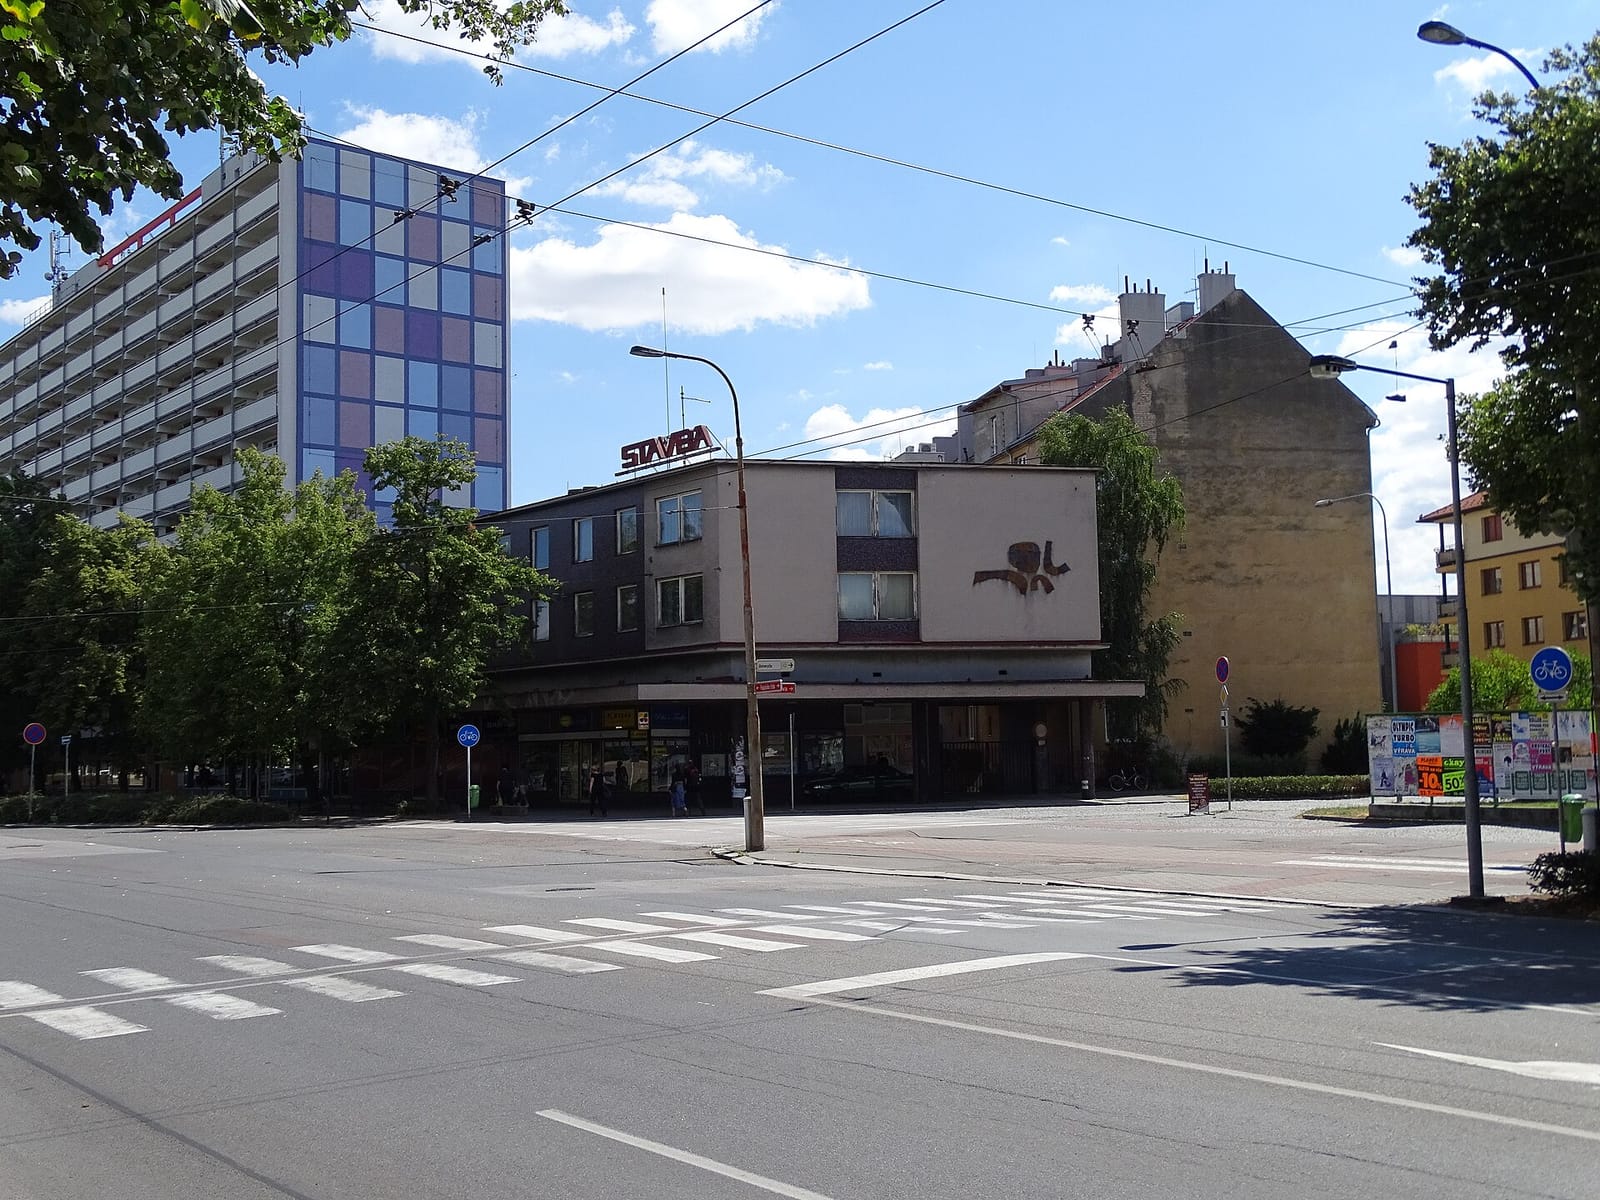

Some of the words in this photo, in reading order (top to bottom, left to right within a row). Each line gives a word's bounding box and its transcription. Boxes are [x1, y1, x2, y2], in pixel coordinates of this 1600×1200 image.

[621, 425, 713, 468] STAVBA
[1393, 722, 1414, 732] OLYMPIC
[1393, 734, 1415, 742] TURBO
